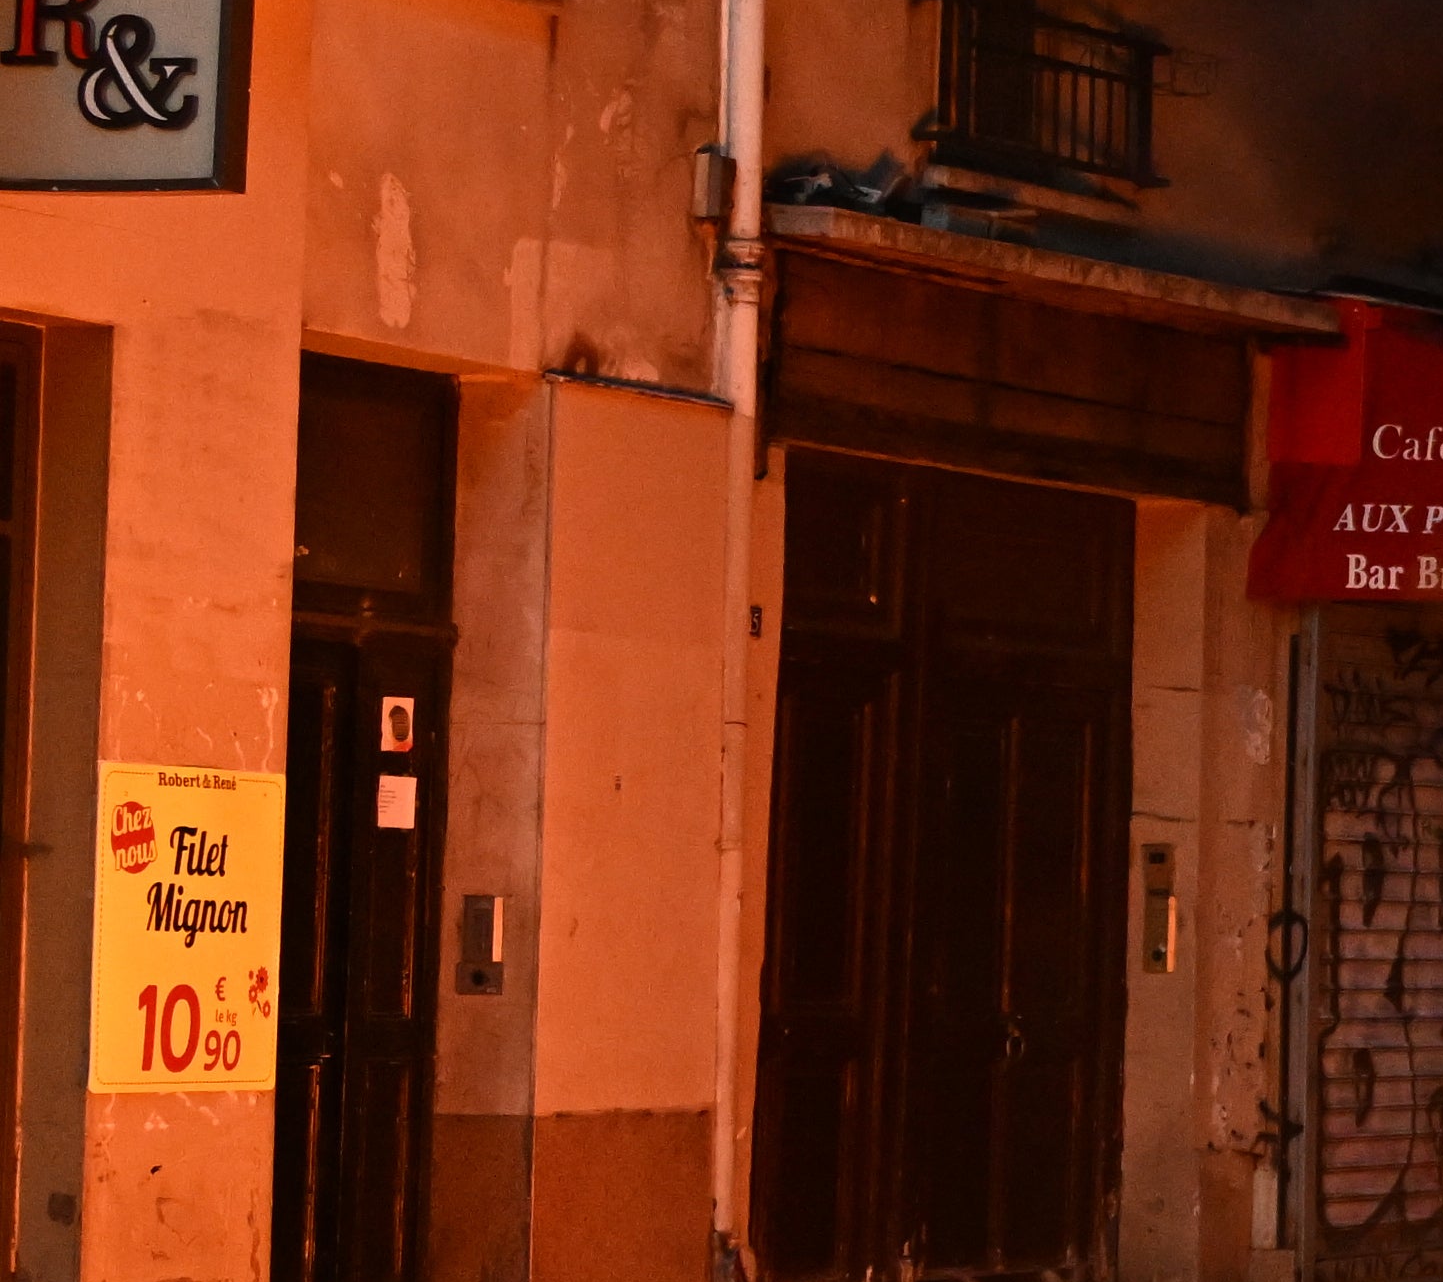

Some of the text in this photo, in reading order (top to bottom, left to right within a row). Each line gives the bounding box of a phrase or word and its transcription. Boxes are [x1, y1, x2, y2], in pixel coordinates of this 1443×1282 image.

[1332, 503, 1414, 535] AUX
[1345, 553, 1403, 591] Bar
[158, 772, 237, 791] Robert & René
[111, 804, 153, 837] Chez
[115, 839, 159, 872] nous
[170, 825, 229, 878] Filet
[146, 881, 248, 949] Mignon
[214, 976, 227, 1002] €
[138, 983, 201, 1073] 10
[215, 1008, 238, 1027] le kg
[203, 1029, 242, 1072] 90
